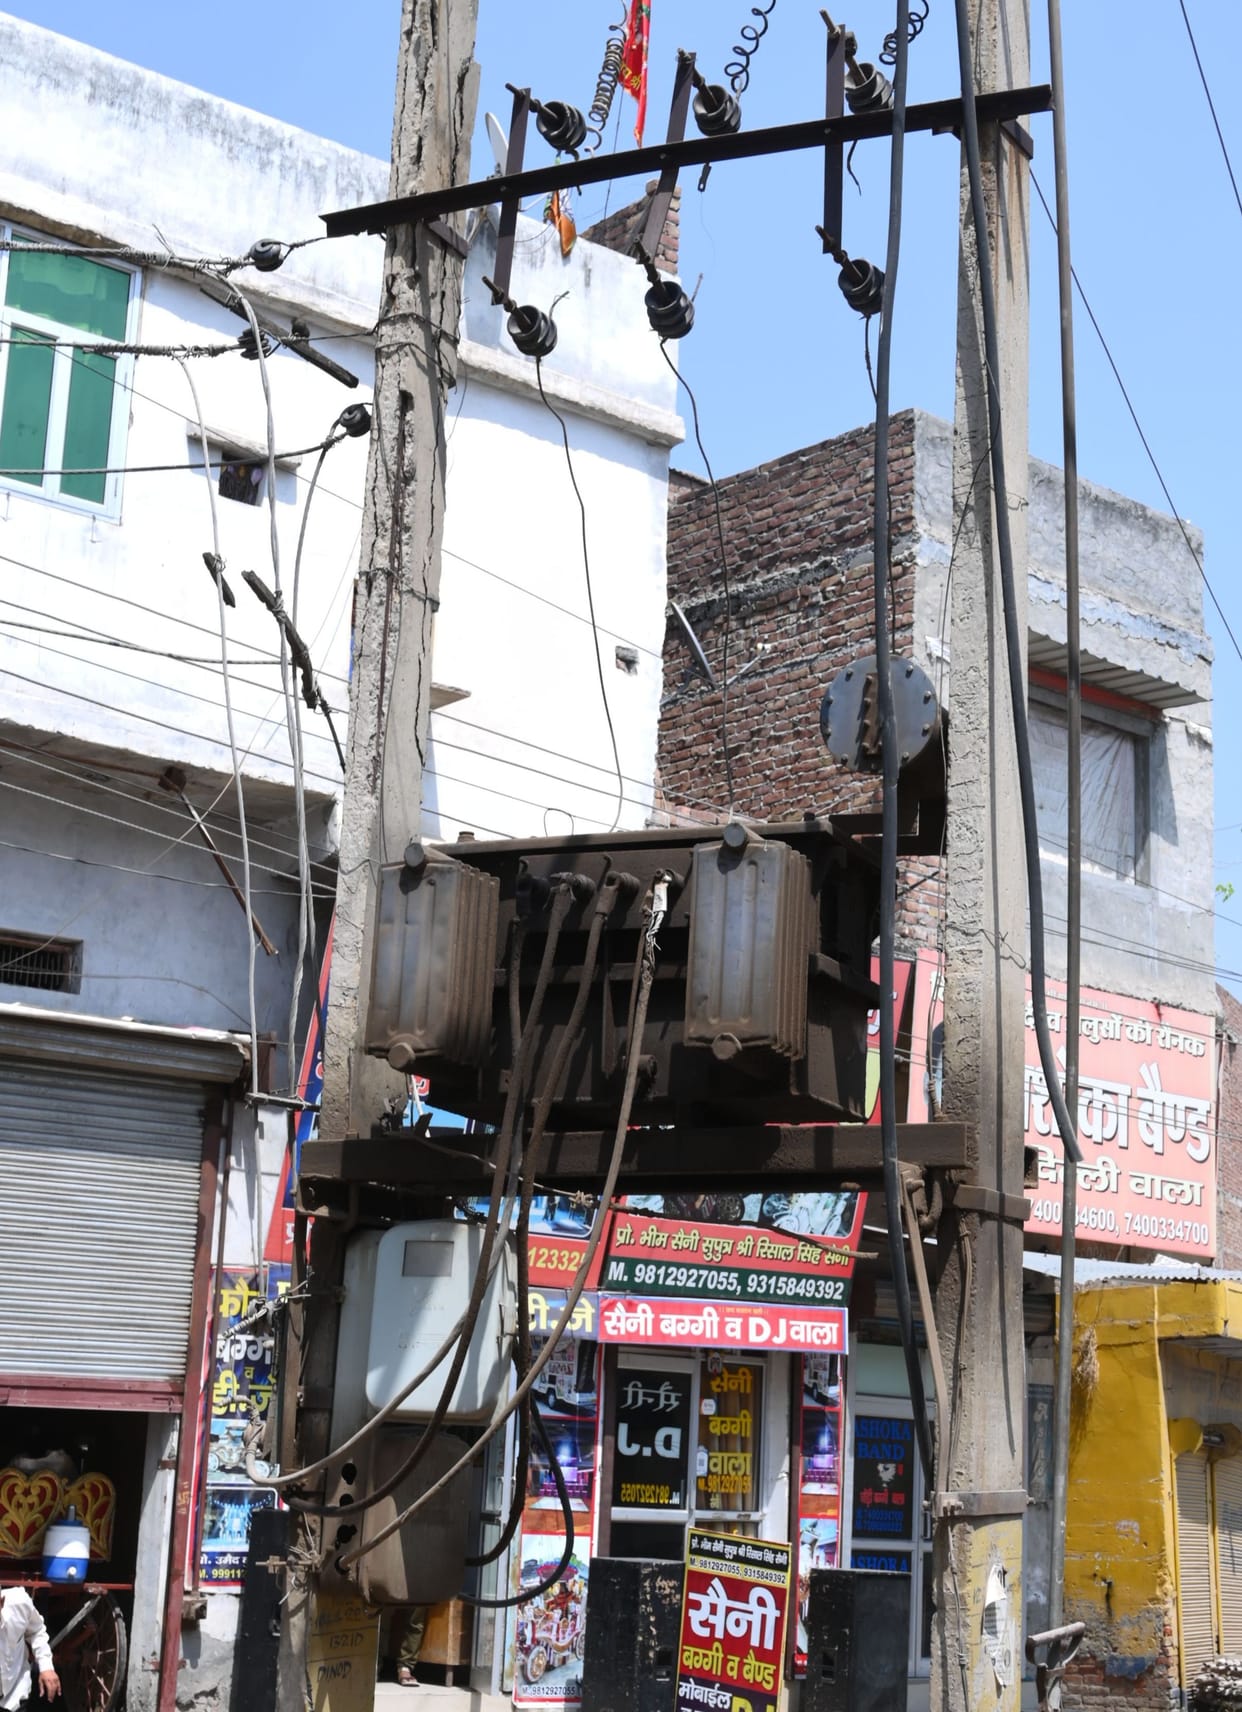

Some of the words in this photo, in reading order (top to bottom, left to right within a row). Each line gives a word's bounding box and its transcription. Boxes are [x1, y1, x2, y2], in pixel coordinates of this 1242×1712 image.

[1079, 1012, 1121, 1045] लुसों
[1137, 1062, 1211, 1162] बैण्ड
[1129, 1170, 1204, 1206] वाला
[615, 1223, 635, 1248] प्रो.
[639, 1225, 668, 1249] भीम
[702, 1236, 734, 1261] सुपुत्र
[736, 1235, 754, 1257] श्री
[756, 1236, 795, 1262] रिसाल
[1124, 1212, 1209, 1245] 7400334700
[608, 1261, 629, 1282] M.
[634, 1263, 741, 1296] 9812927055,
[746, 1274, 845, 1300] 9315849392
[604, 1302, 654, 1337] सैनी
[659, 1306, 719, 1340] बग्गी
[725, 1316, 742, 1340] व
[708, 1409, 753, 1438] बग्गी
[708, 1451, 752, 1477] वाला
[856, 1441, 905, 1461] BAND
[687, 1577, 781, 1651] सैनी
[682, 1641, 724, 1677] बग्गी
[726, 1655, 740, 1680] व
[742, 1650, 776, 1691] बैण्ड
[678, 1677, 732, 1709] मोबाईल
